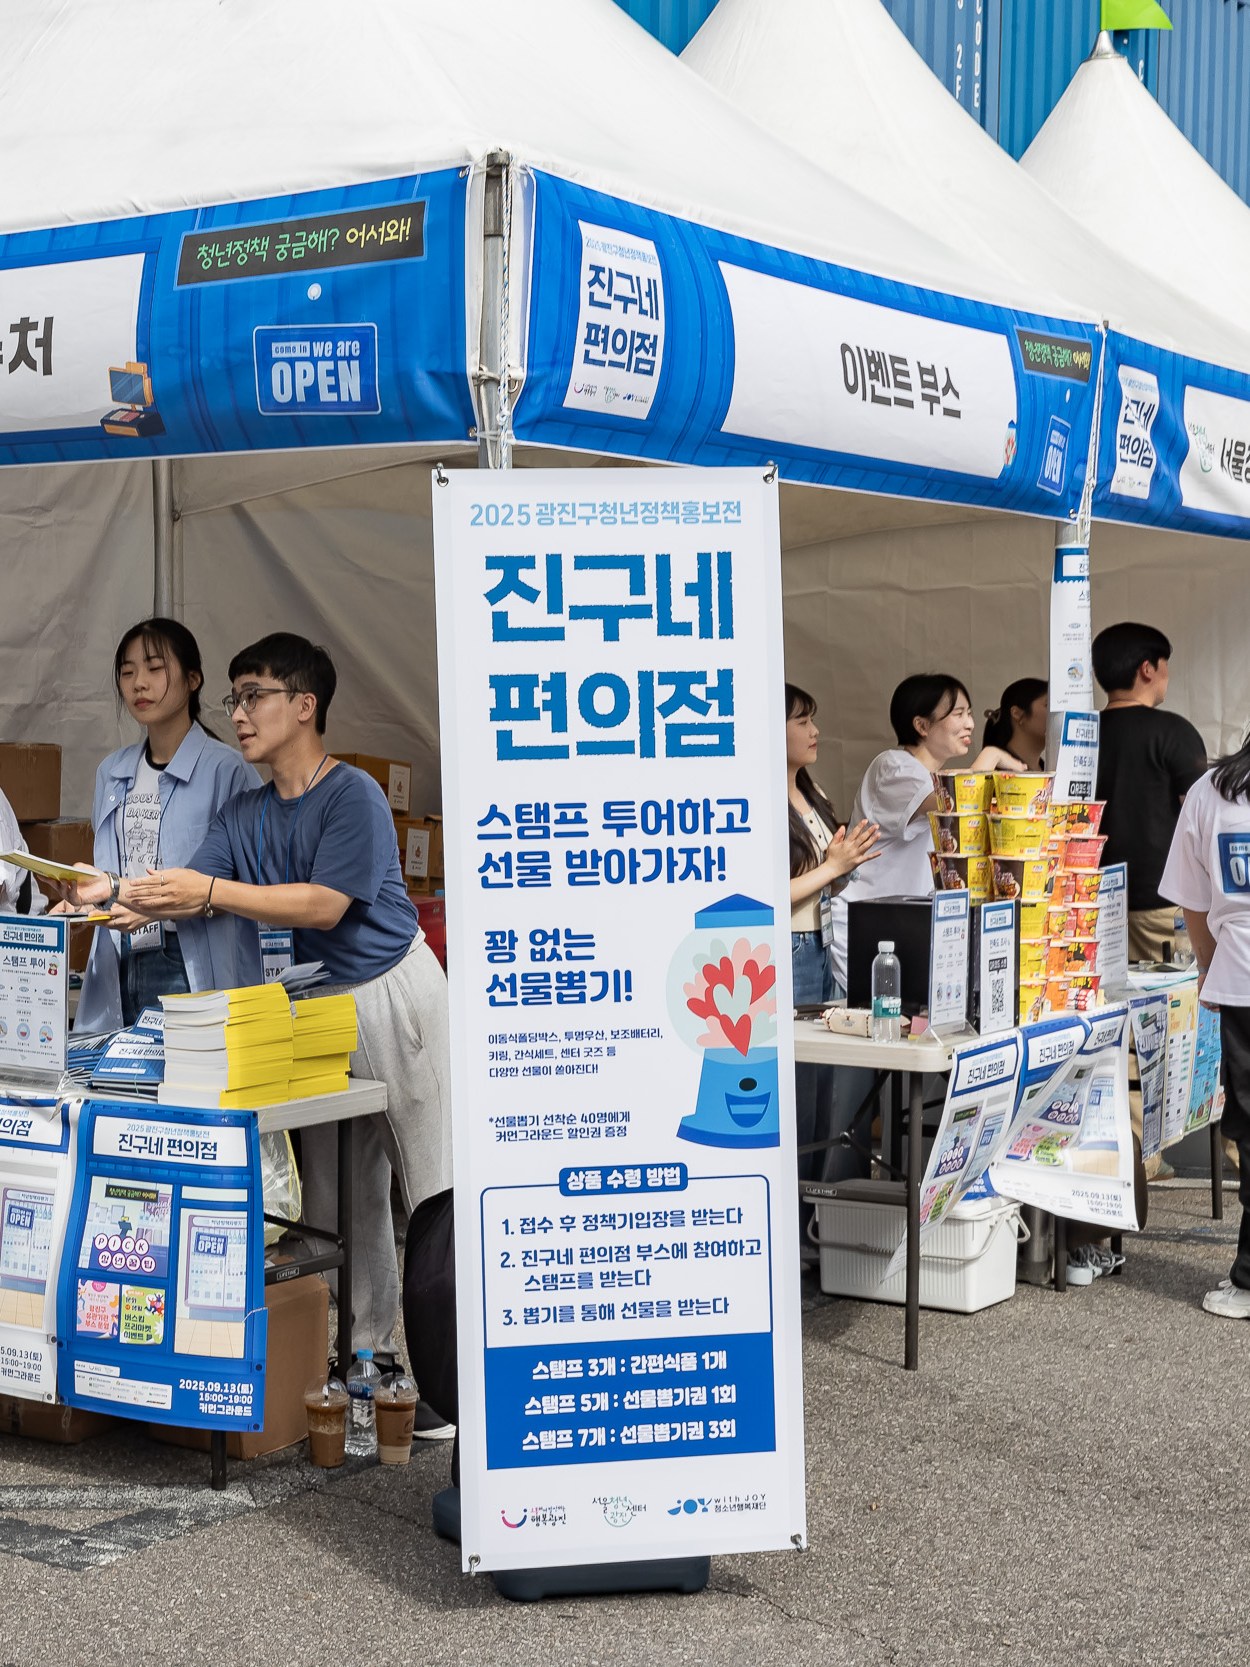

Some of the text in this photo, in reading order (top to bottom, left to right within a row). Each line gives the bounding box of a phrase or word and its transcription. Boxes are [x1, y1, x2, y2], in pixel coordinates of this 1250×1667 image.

[197, 216, 412, 271] 청년정책 궁금해? 어서와!
[587, 263, 660, 321] 진구네
[313, 341, 333, 357] we
[336, 340, 361, 357] are
[583, 322, 659, 378] 편의점
[271, 360, 361, 404] OPEN
[840, 342, 961, 419] 이벤트 부스
[1120, 433, 1154, 469] 편의점
[470, 500, 742, 527] 2025 광진구청년정책홍보전
[483, 551, 734, 642] 진구네
[488, 668, 736, 761] 편의점
[476, 798, 752, 841] 스탬프 투어하고
[477, 846, 727, 889] 선물 받아가자!
[3, 930, 45, 943] 진구네 편의점
[484, 927, 596, 964] 꽝 없는
[2, 955, 46, 970] 스탬프 투어
[485, 968, 633, 1007] 선물뽑기!
[564, 1030, 608, 1042] 투명우산,
[610, 1027, 664, 1040] 보조배터리,
[488, 1045, 617, 1062] 키링, 간식세트, 센터 굿즈 등
[489, 1066, 519, 1078] 다양한
[521, 1065, 552, 1077] 선물이
[127, 1123, 145, 1132] 2025
[543, 1112, 578, 1127] 선착순
[580, 1111, 631, 1125] 40명에게
[118, 1133, 218, 1160] 진구네 편의점
[495, 1125, 627, 1143] 커먼그라운드 할인권 증정
[566, 1165, 681, 1192] 상품 수령 방법
[9, 1213, 31, 1226] OPEN
[502, 1207, 744, 1235] 1. 접수 후 정책기입장을 받는다
[98, 1236, 145, 1252] PICK
[198, 1240, 224, 1255] OPEN
[500, 1238, 762, 1269] 2. 진구네 편의점 부스에 참여하고
[278, 1269, 298, 1279] LIFETIME
[524, 1268, 652, 1292] 스탬프를 받는다
[502, 1297, 730, 1326] 3. 뽑기를 통해 선물을 받는다
[1, 1367, 41, 1383] 커먼그라운드
[532, 1350, 727, 1380] 스탬프 3개 간편식품 1개
[179, 1378, 254, 1394] 2025.09.13(토)
[199, 1403, 253, 1417] 커먼그라운드
[524, 1384, 737, 1416] 스탬프 5개 선물뽑기권 1회
[522, 1418, 736, 1451] 스탬프 7개 선물뽑기권 3회
[714, 1493, 767, 1504] with JOY
[531, 1514, 567, 1527] 행복광진
